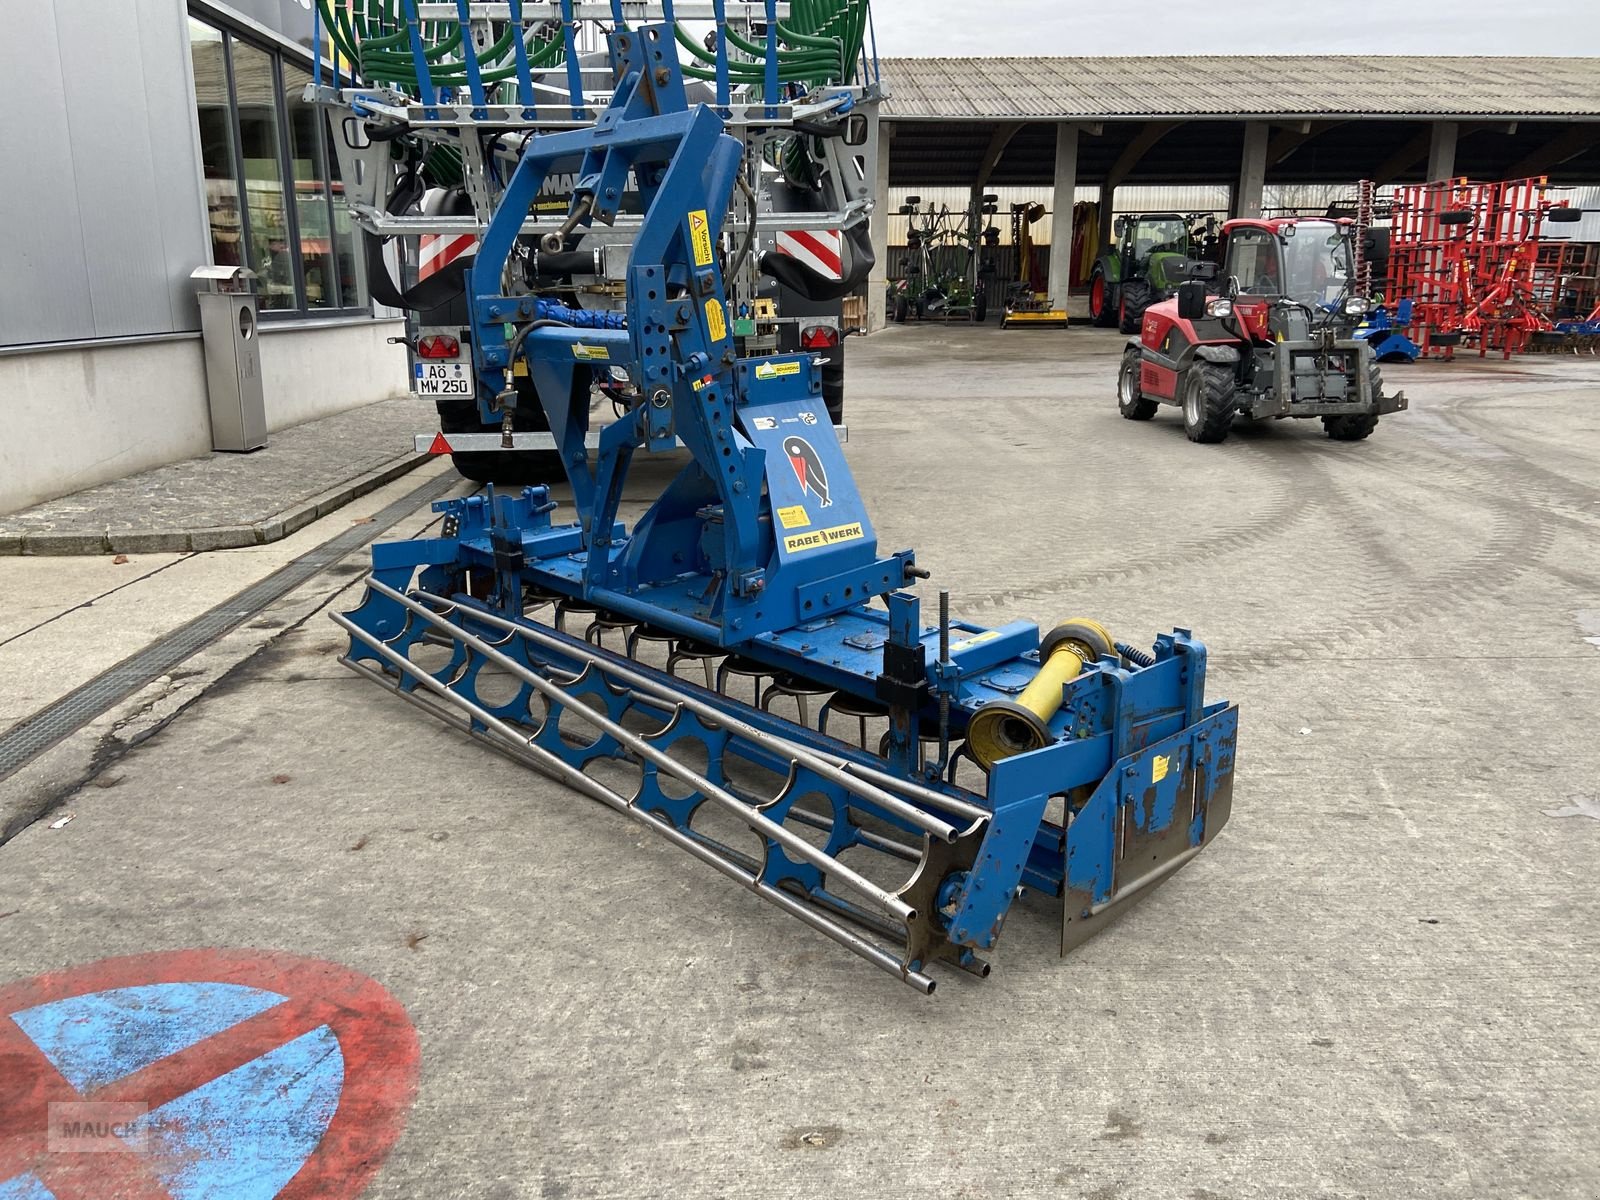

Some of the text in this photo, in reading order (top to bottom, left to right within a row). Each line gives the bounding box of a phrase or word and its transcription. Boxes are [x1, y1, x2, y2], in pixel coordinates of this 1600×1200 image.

[701, 229, 711, 262] Vorsicht
[429, 365, 447, 379] AÖ
[421, 380, 467, 393] MW 250
[788, 527, 861, 549] RABE WERK
